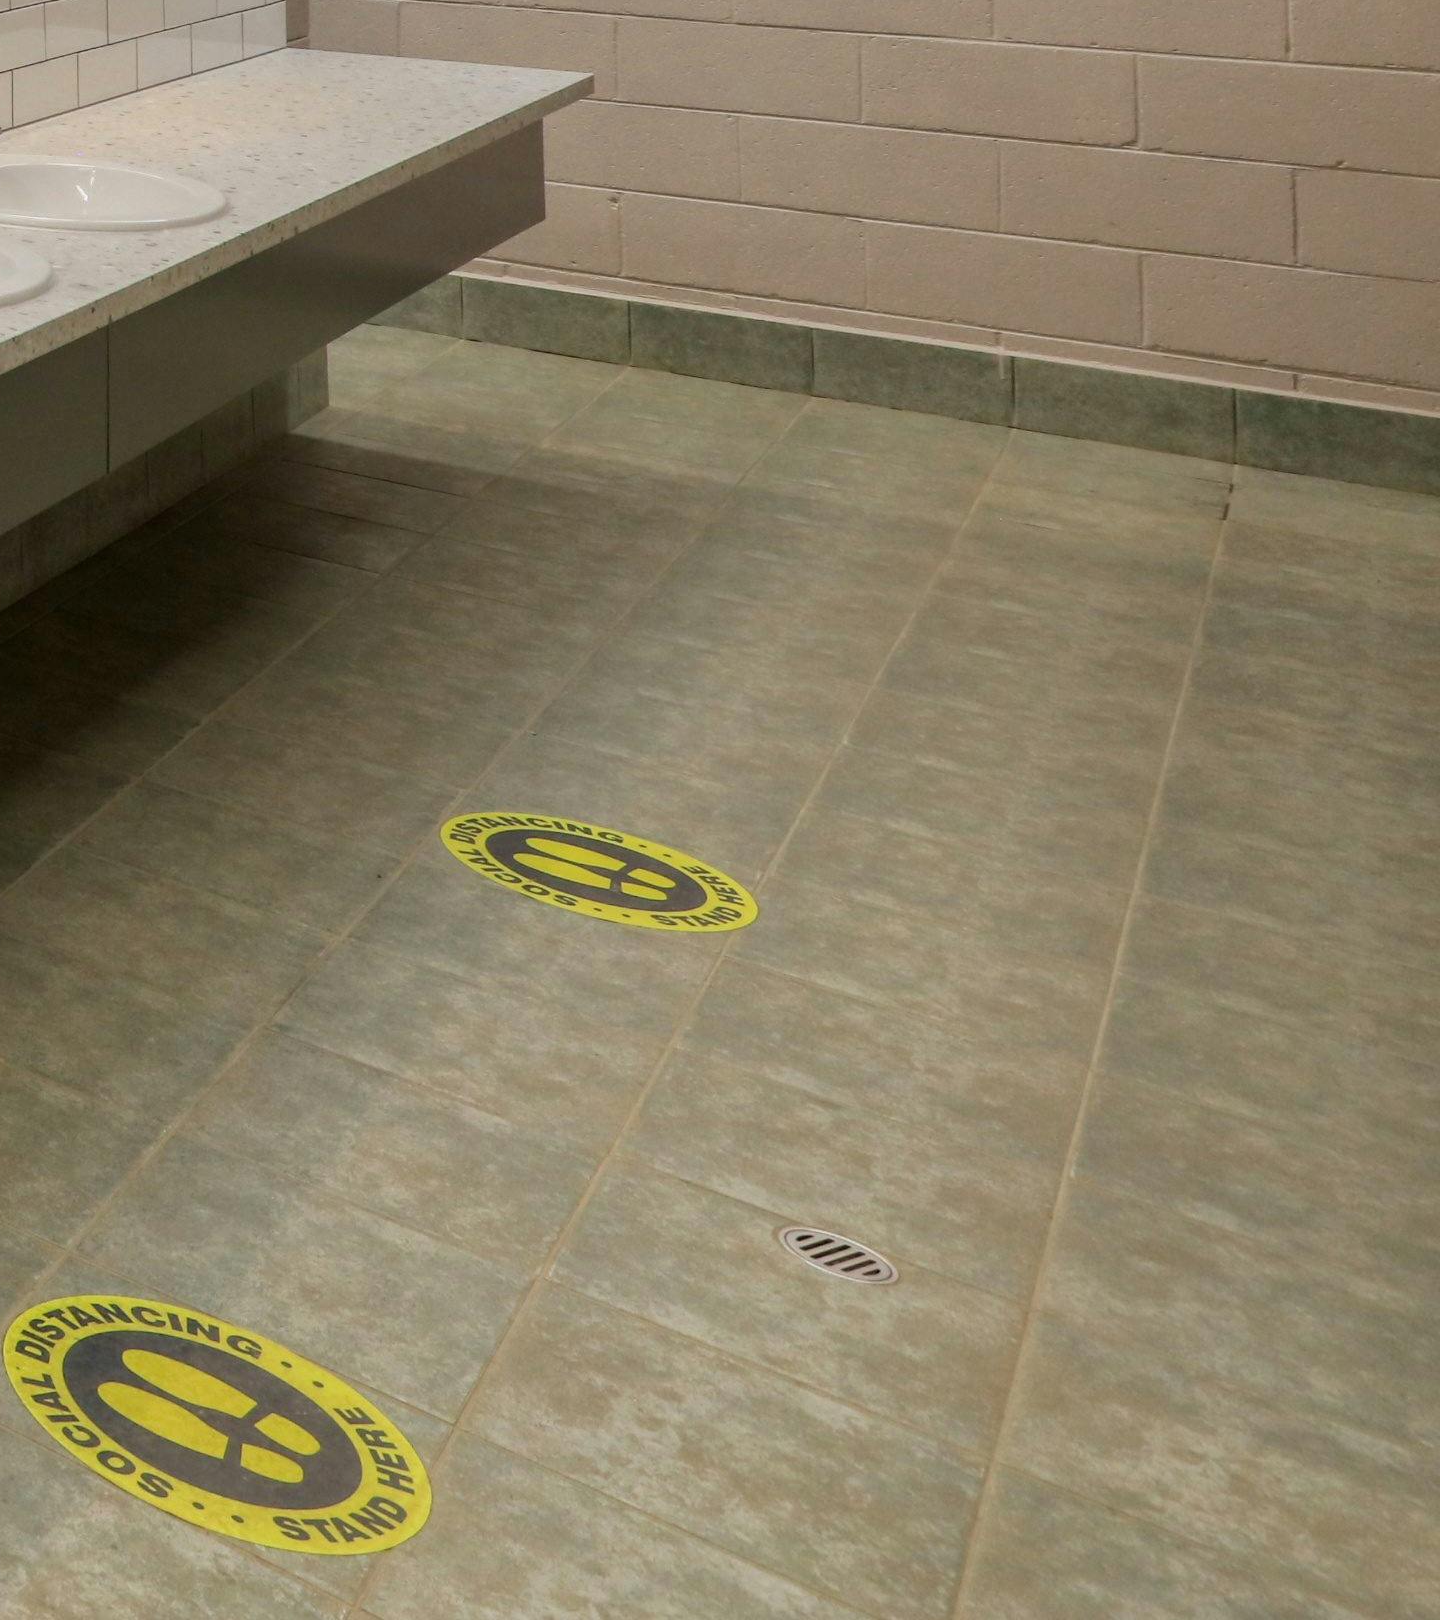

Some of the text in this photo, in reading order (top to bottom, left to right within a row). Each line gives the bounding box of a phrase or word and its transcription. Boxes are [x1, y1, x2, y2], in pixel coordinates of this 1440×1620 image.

[449, 815, 624, 907] SOCIAL DISTANCING
[650, 865, 746, 928] STAND HERE
[15, 1303, 263, 1498] SOCIAL DISTANCING
[272, 1406, 415, 1544] STAND HERE
